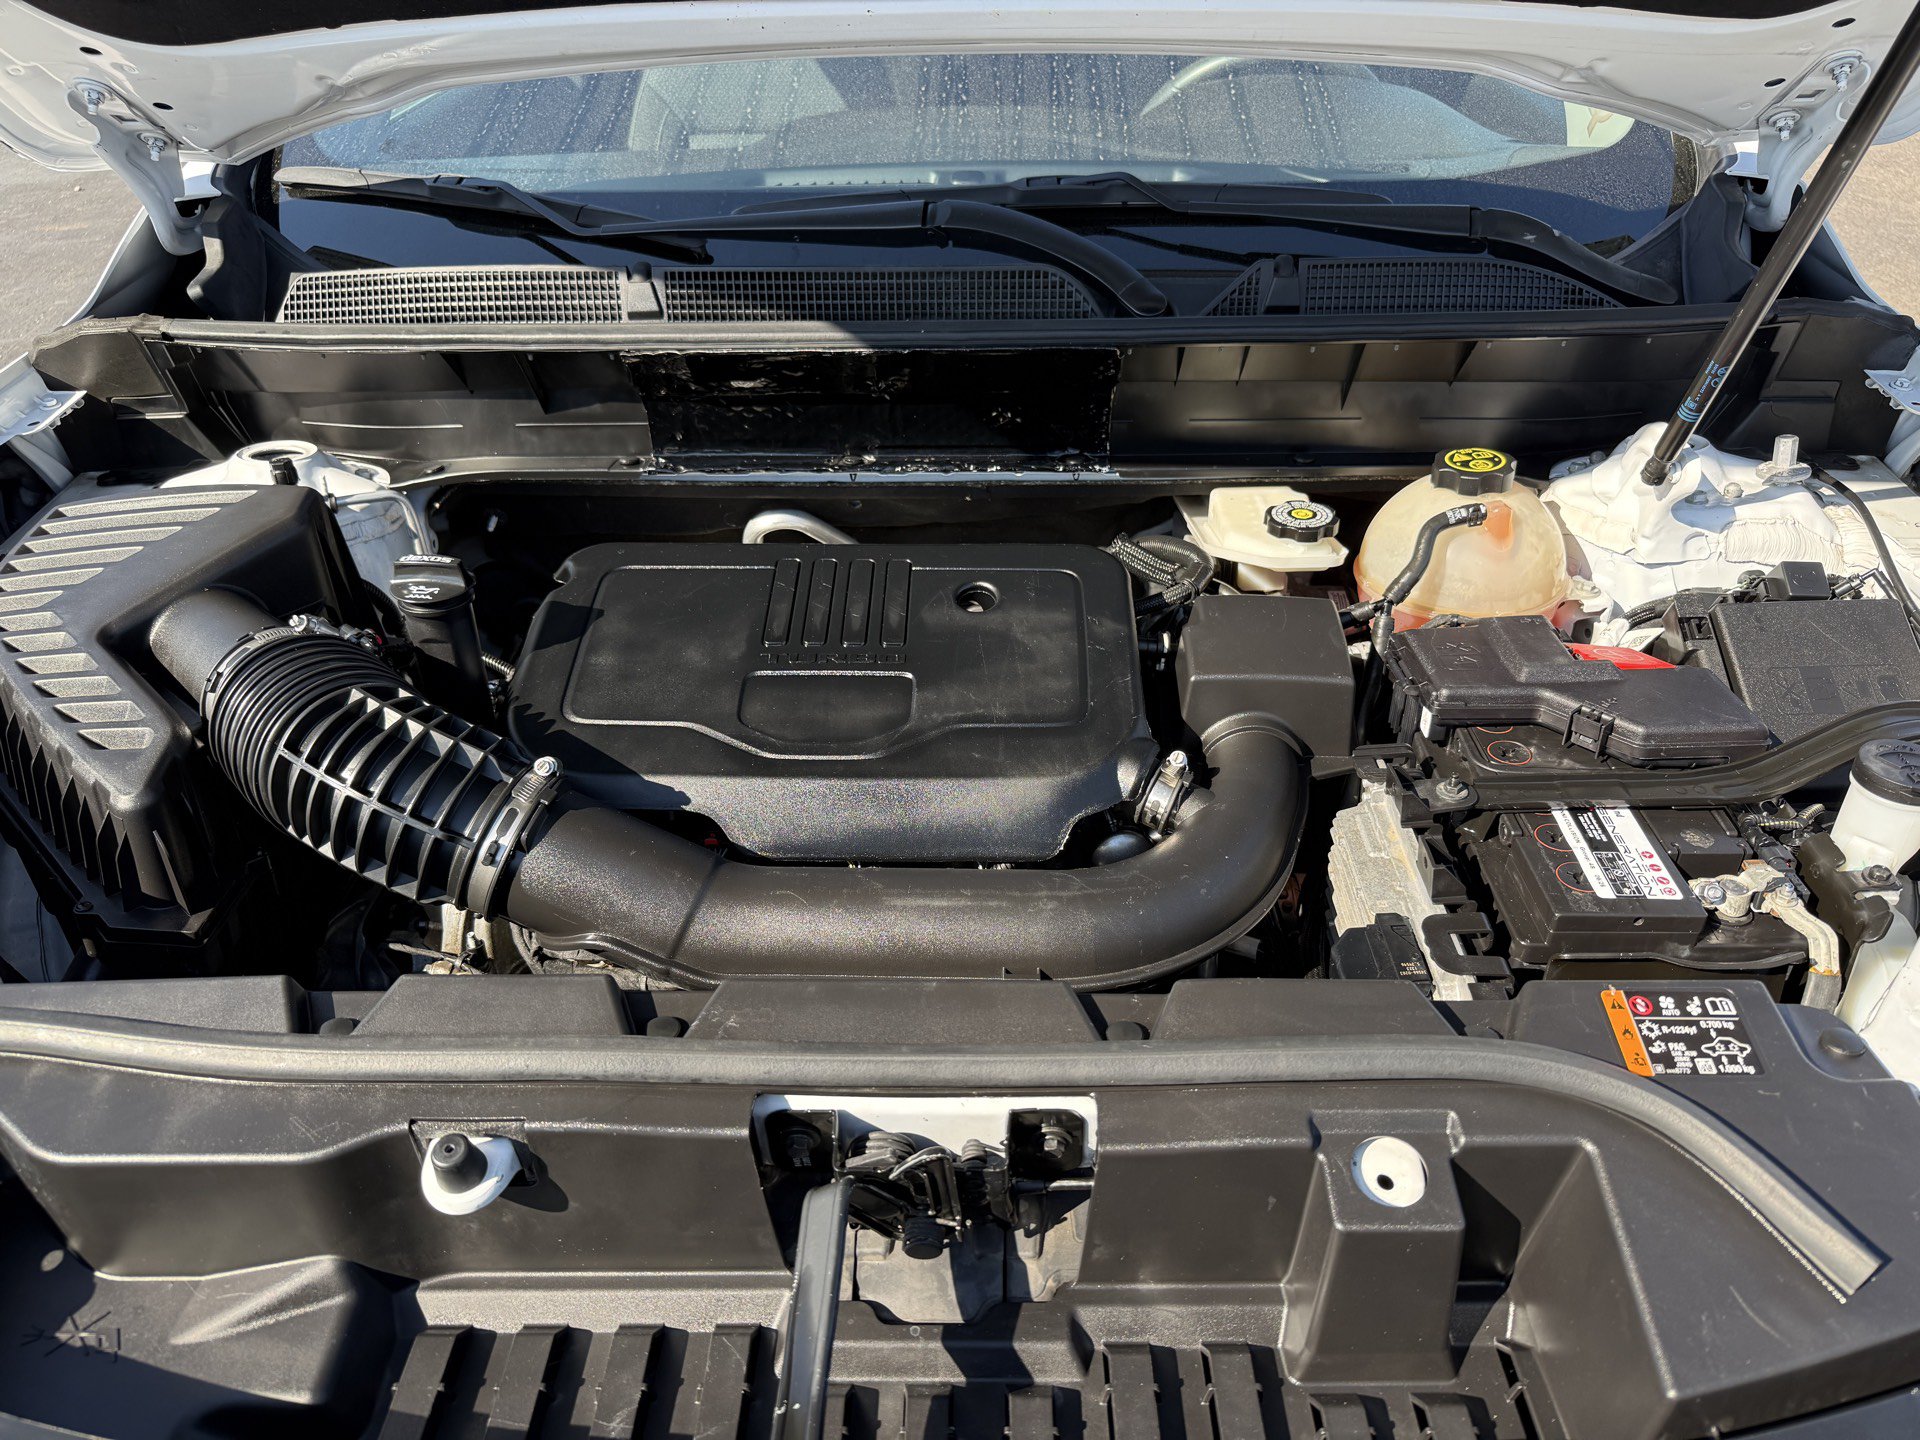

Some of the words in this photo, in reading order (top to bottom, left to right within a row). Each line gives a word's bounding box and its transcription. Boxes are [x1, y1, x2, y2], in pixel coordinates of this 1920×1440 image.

[399, 554, 455, 564] dexos
[760, 653, 907, 664] TURBO
[1722, 1021, 1735, 1030] kg
[1661, 1026, 1697, 1036] R-1234yf
[1668, 1042, 1687, 1051] PAG
[1742, 1065, 1756, 1074] kg
